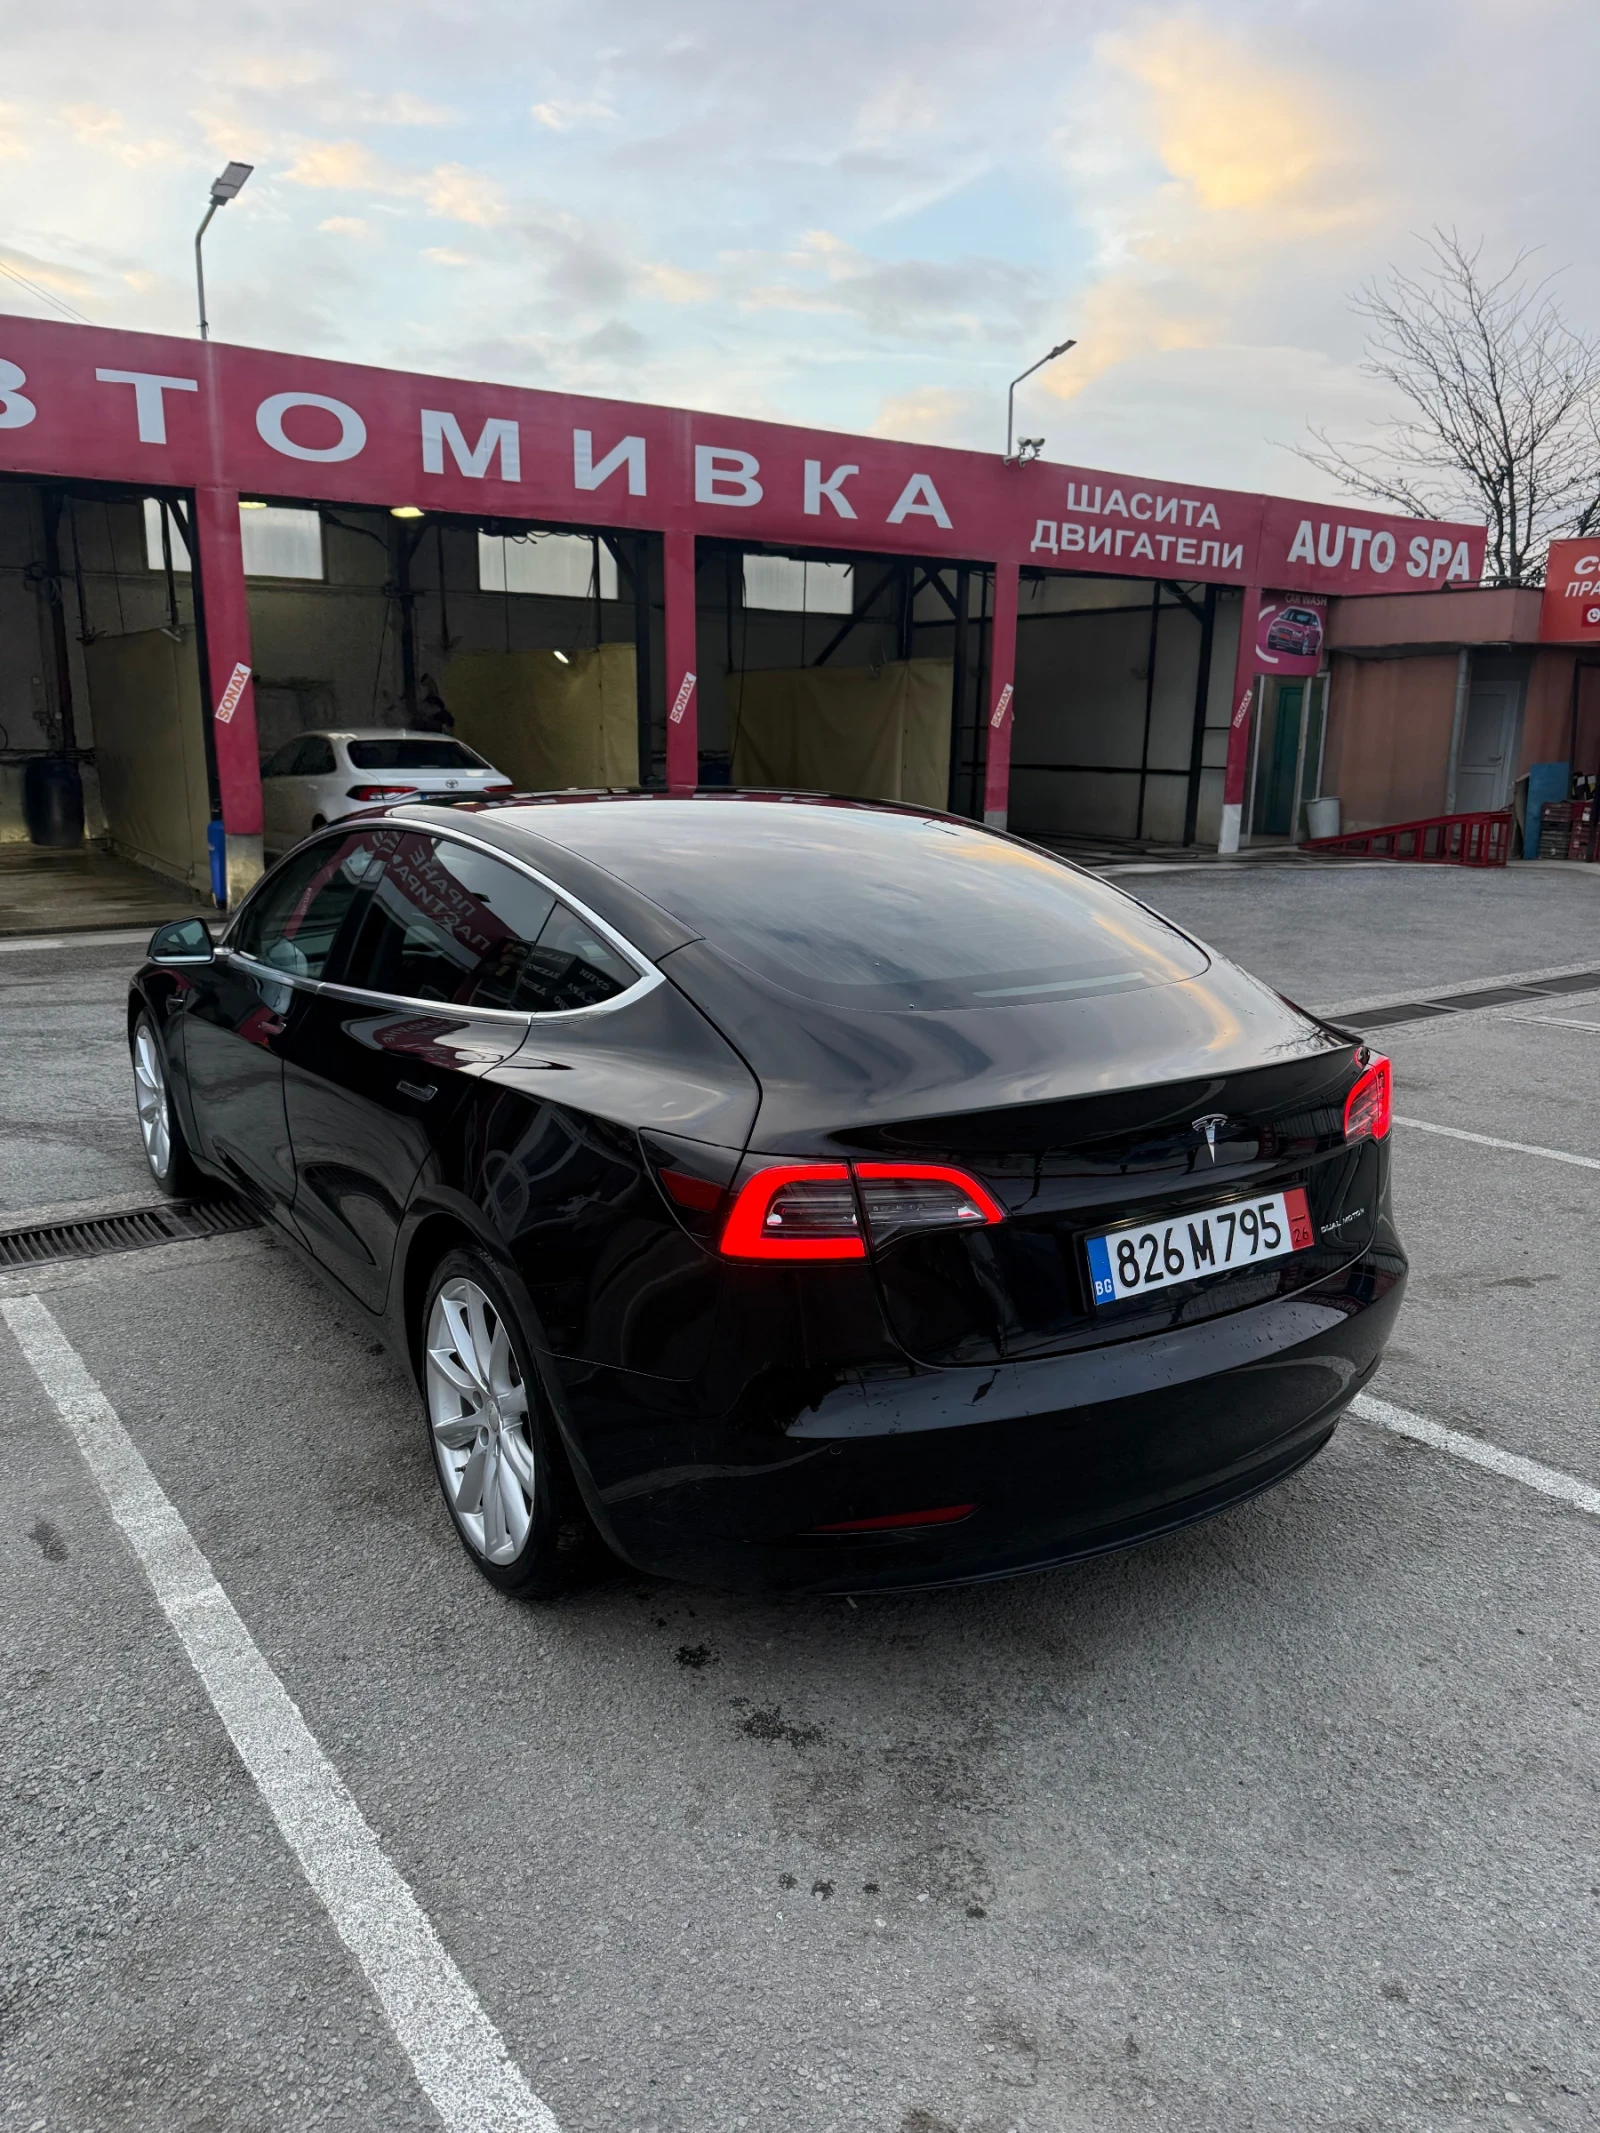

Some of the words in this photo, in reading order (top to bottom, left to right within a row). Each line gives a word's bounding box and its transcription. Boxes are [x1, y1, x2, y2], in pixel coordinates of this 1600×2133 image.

[1067, 482, 1221, 531] ШАСИТА
[1030, 518, 1244, 570] ДВИГАТЕЛИ
[1287, 520, 1396, 574] AUTO
[1406, 535, 1471, 581] SPA
[1285, 592, 1301, 604] CAR
[1302, 594, 1328, 606] WASH
[217, 667, 248, 721] SONAX
[671, 677, 693, 722] SONAX
[992, 688, 1011, 726] SONAX
[1293, 1227, 1309, 1243] 26
[1321, 1219, 1342, 1235] DUAL
[1343, 1207, 1366, 1225] MOTOR
[1094, 1279, 1113, 1296] BG
